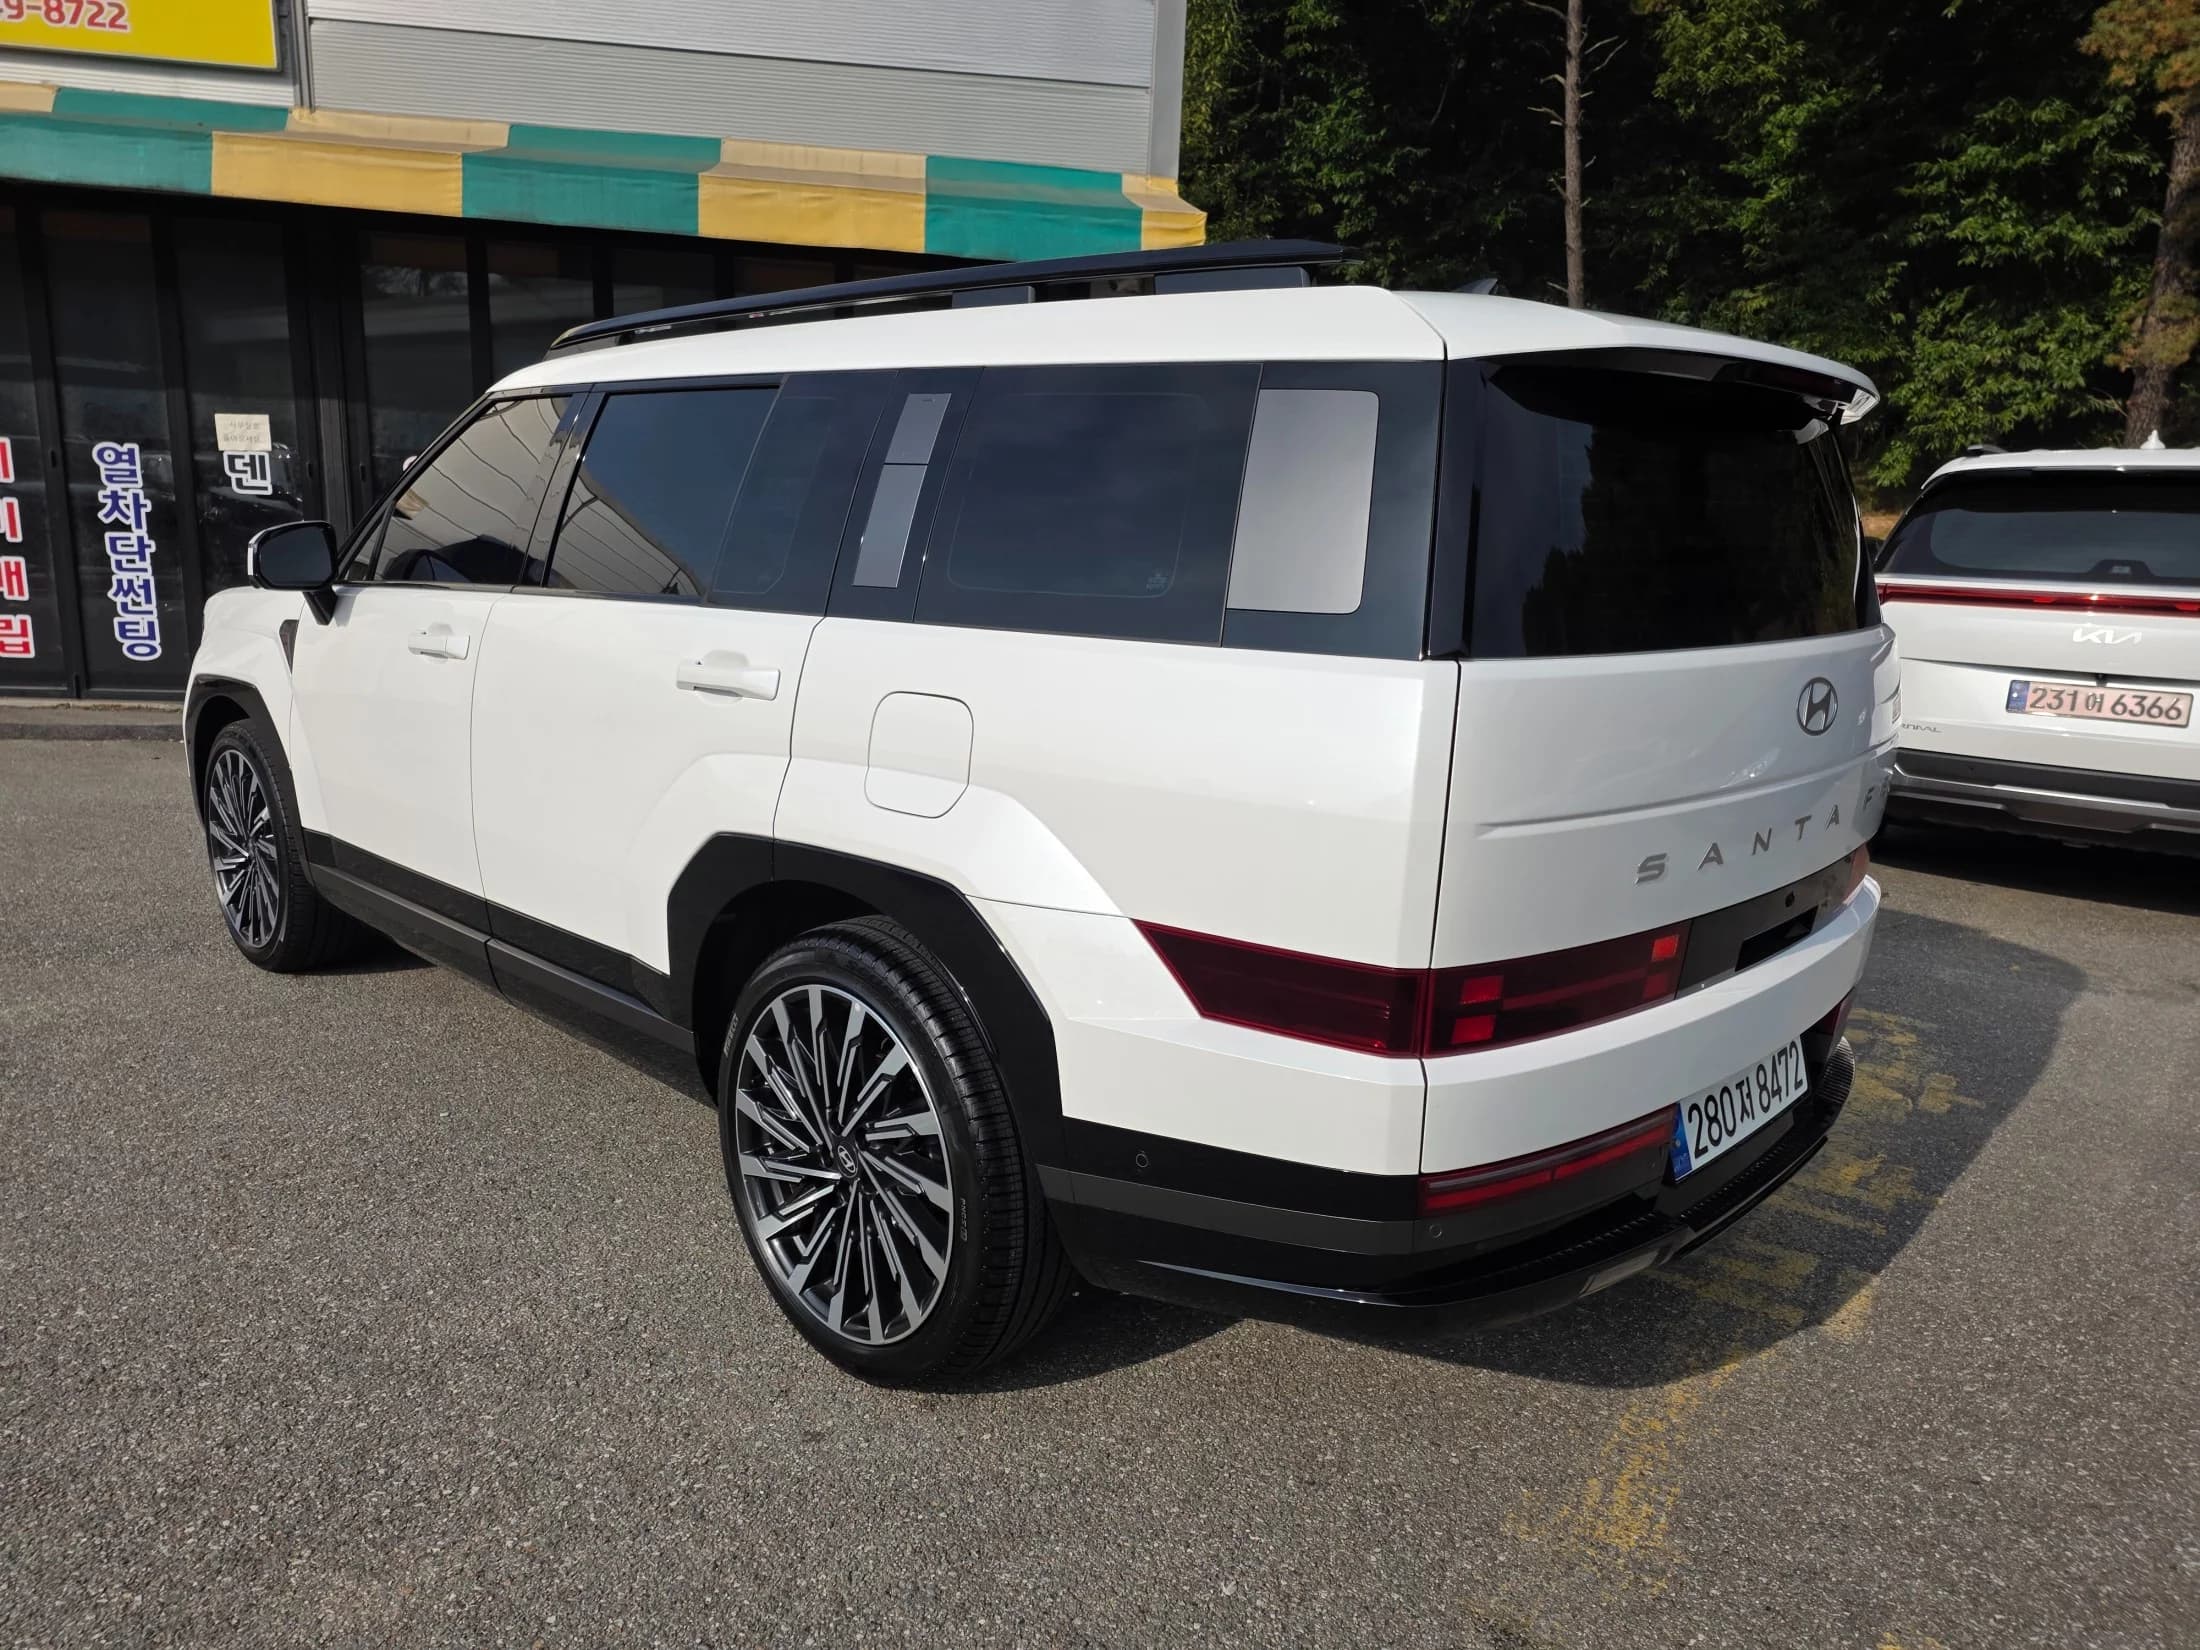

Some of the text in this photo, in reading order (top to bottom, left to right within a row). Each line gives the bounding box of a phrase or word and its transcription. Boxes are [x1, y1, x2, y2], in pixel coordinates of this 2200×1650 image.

[0, 0, 128, 31] 9-8722
[223, 451, 273, 495] 덴
[2110, 694, 2183, 721] 6366
[1634, 803, 1841, 887] SANTA
[1687, 1040, 1804, 1159] 280저 8472
